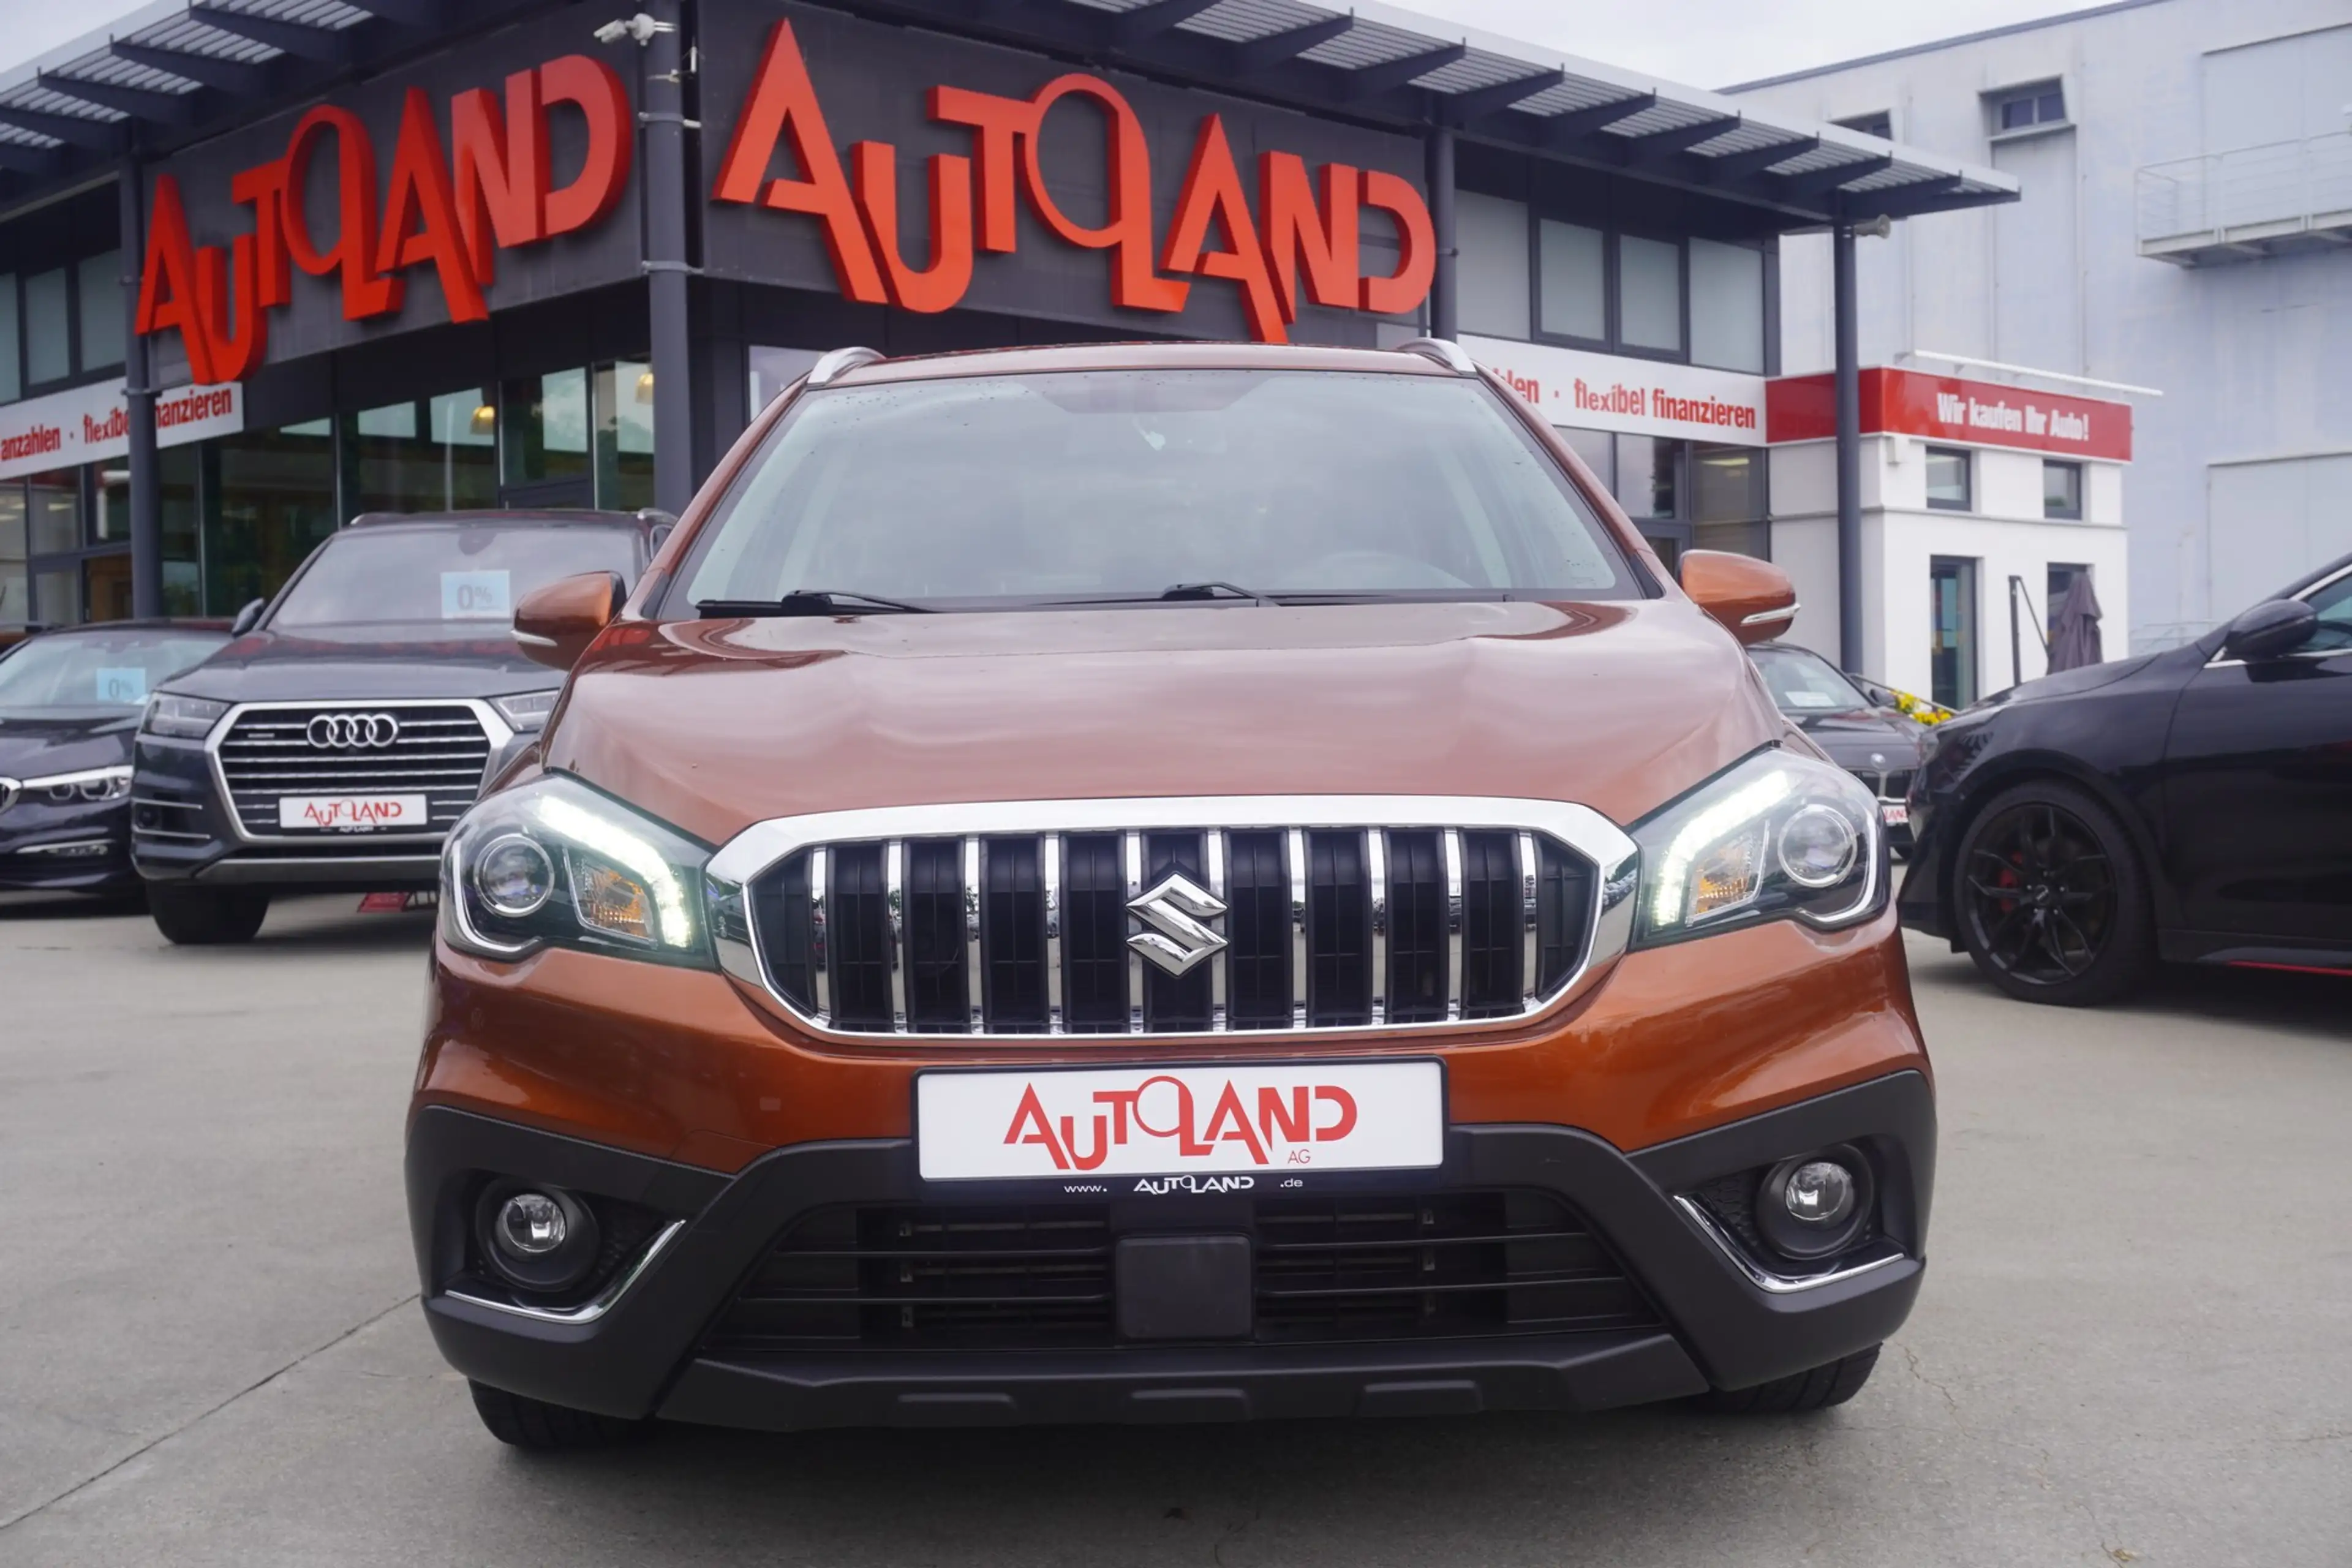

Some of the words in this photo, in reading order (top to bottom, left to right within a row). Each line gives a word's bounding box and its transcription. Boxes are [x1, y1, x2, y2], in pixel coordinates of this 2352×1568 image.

[710, 17, 1437, 344] AUTOLAND
[134, 54, 632, 385] AUTOLAND
[1574, 377, 1646, 416] flexibel
[1653, 388, 1756, 429] finanzieren
[1937, 393, 1966, 424] Wir
[1969, 397, 2022, 431] kaufen
[2025, 405, 2046, 435] Ihr
[2049, 409, 2089, 441] Auto!
[1, 424, 61, 461] anzahlen
[456, 584, 493, 611] 0%
[304, 798, 402, 826] AUTOLAND
[1003, 1075, 1358, 1171] AUTOLAND
[1287, 1149, 1311, 1164] AG
[1063, 1185, 1107, 1193] www.
[1133, 1175, 1255, 1195] AUTOLAND
[1280, 1178, 1303, 1188] .de
